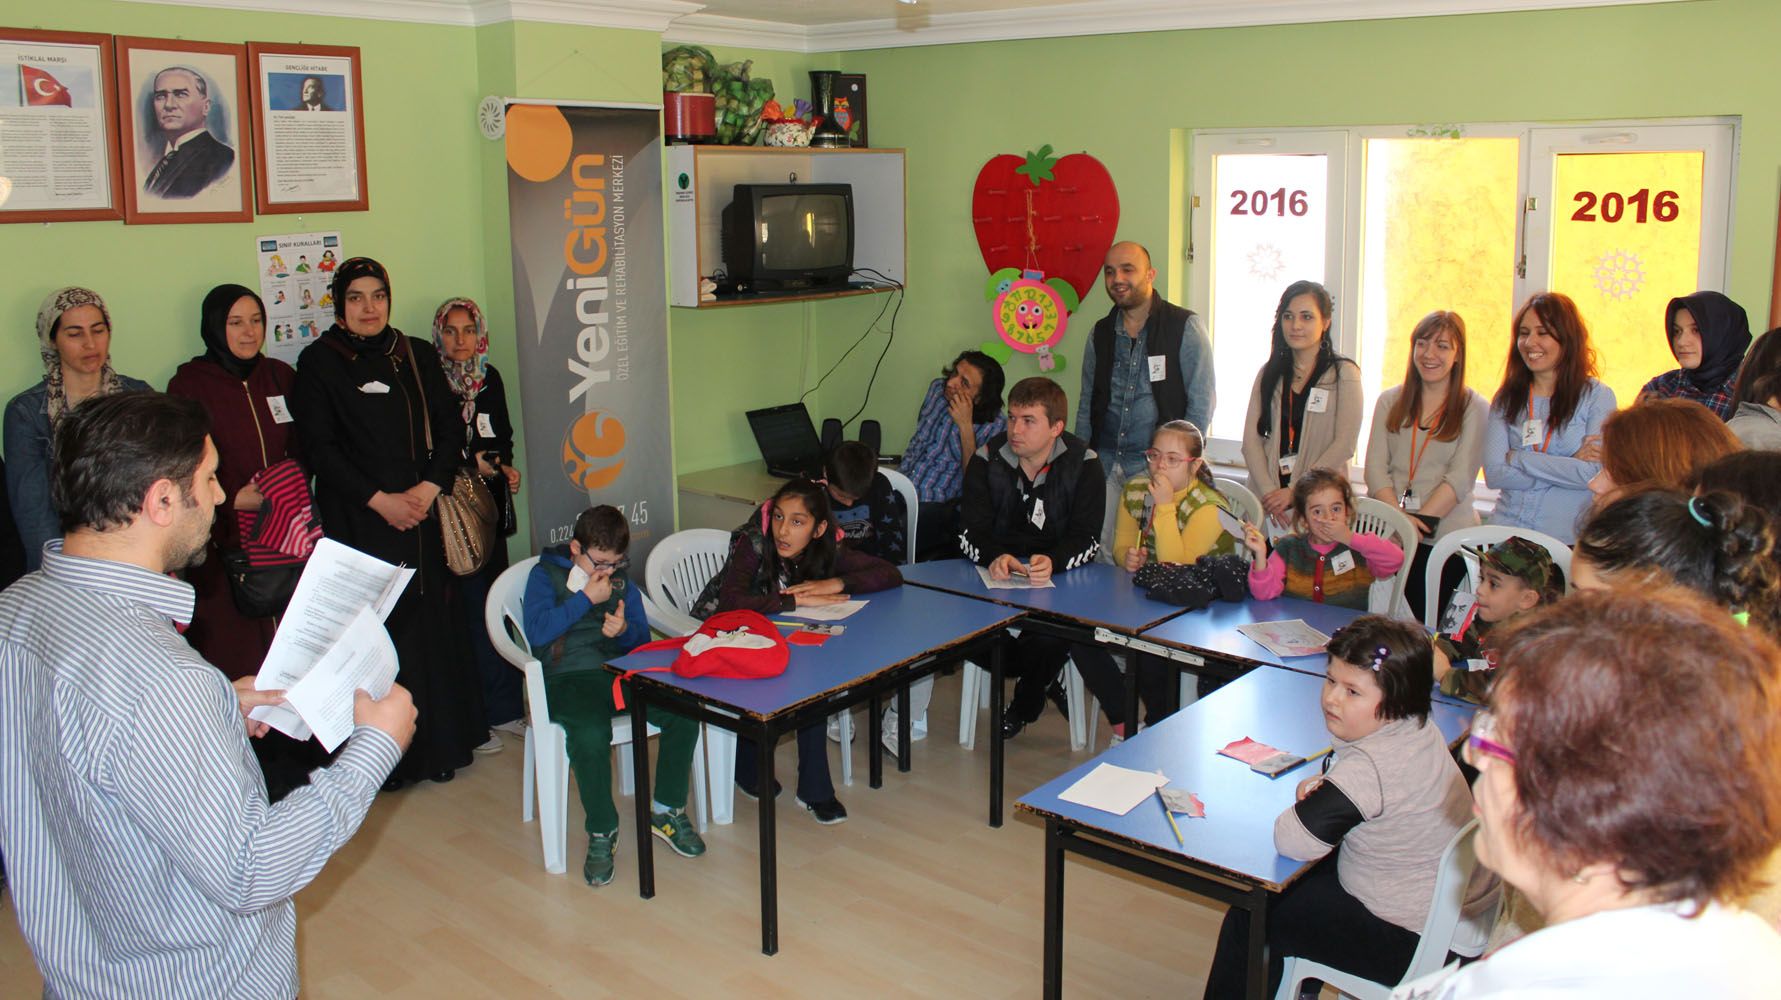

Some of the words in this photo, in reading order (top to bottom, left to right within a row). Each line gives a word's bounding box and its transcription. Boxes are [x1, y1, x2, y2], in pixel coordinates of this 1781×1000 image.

[610, 155, 624, 202] MERKEZİ
[1230, 187, 1309, 217] 2016
[1570, 188, 1680, 224] 2016
[612, 206, 627, 295] REHABİLİTASYON
[616, 299, 627, 314] VE
[615, 316, 628, 350] EĞİTİM
[616, 356, 629, 381] ÖZEL
